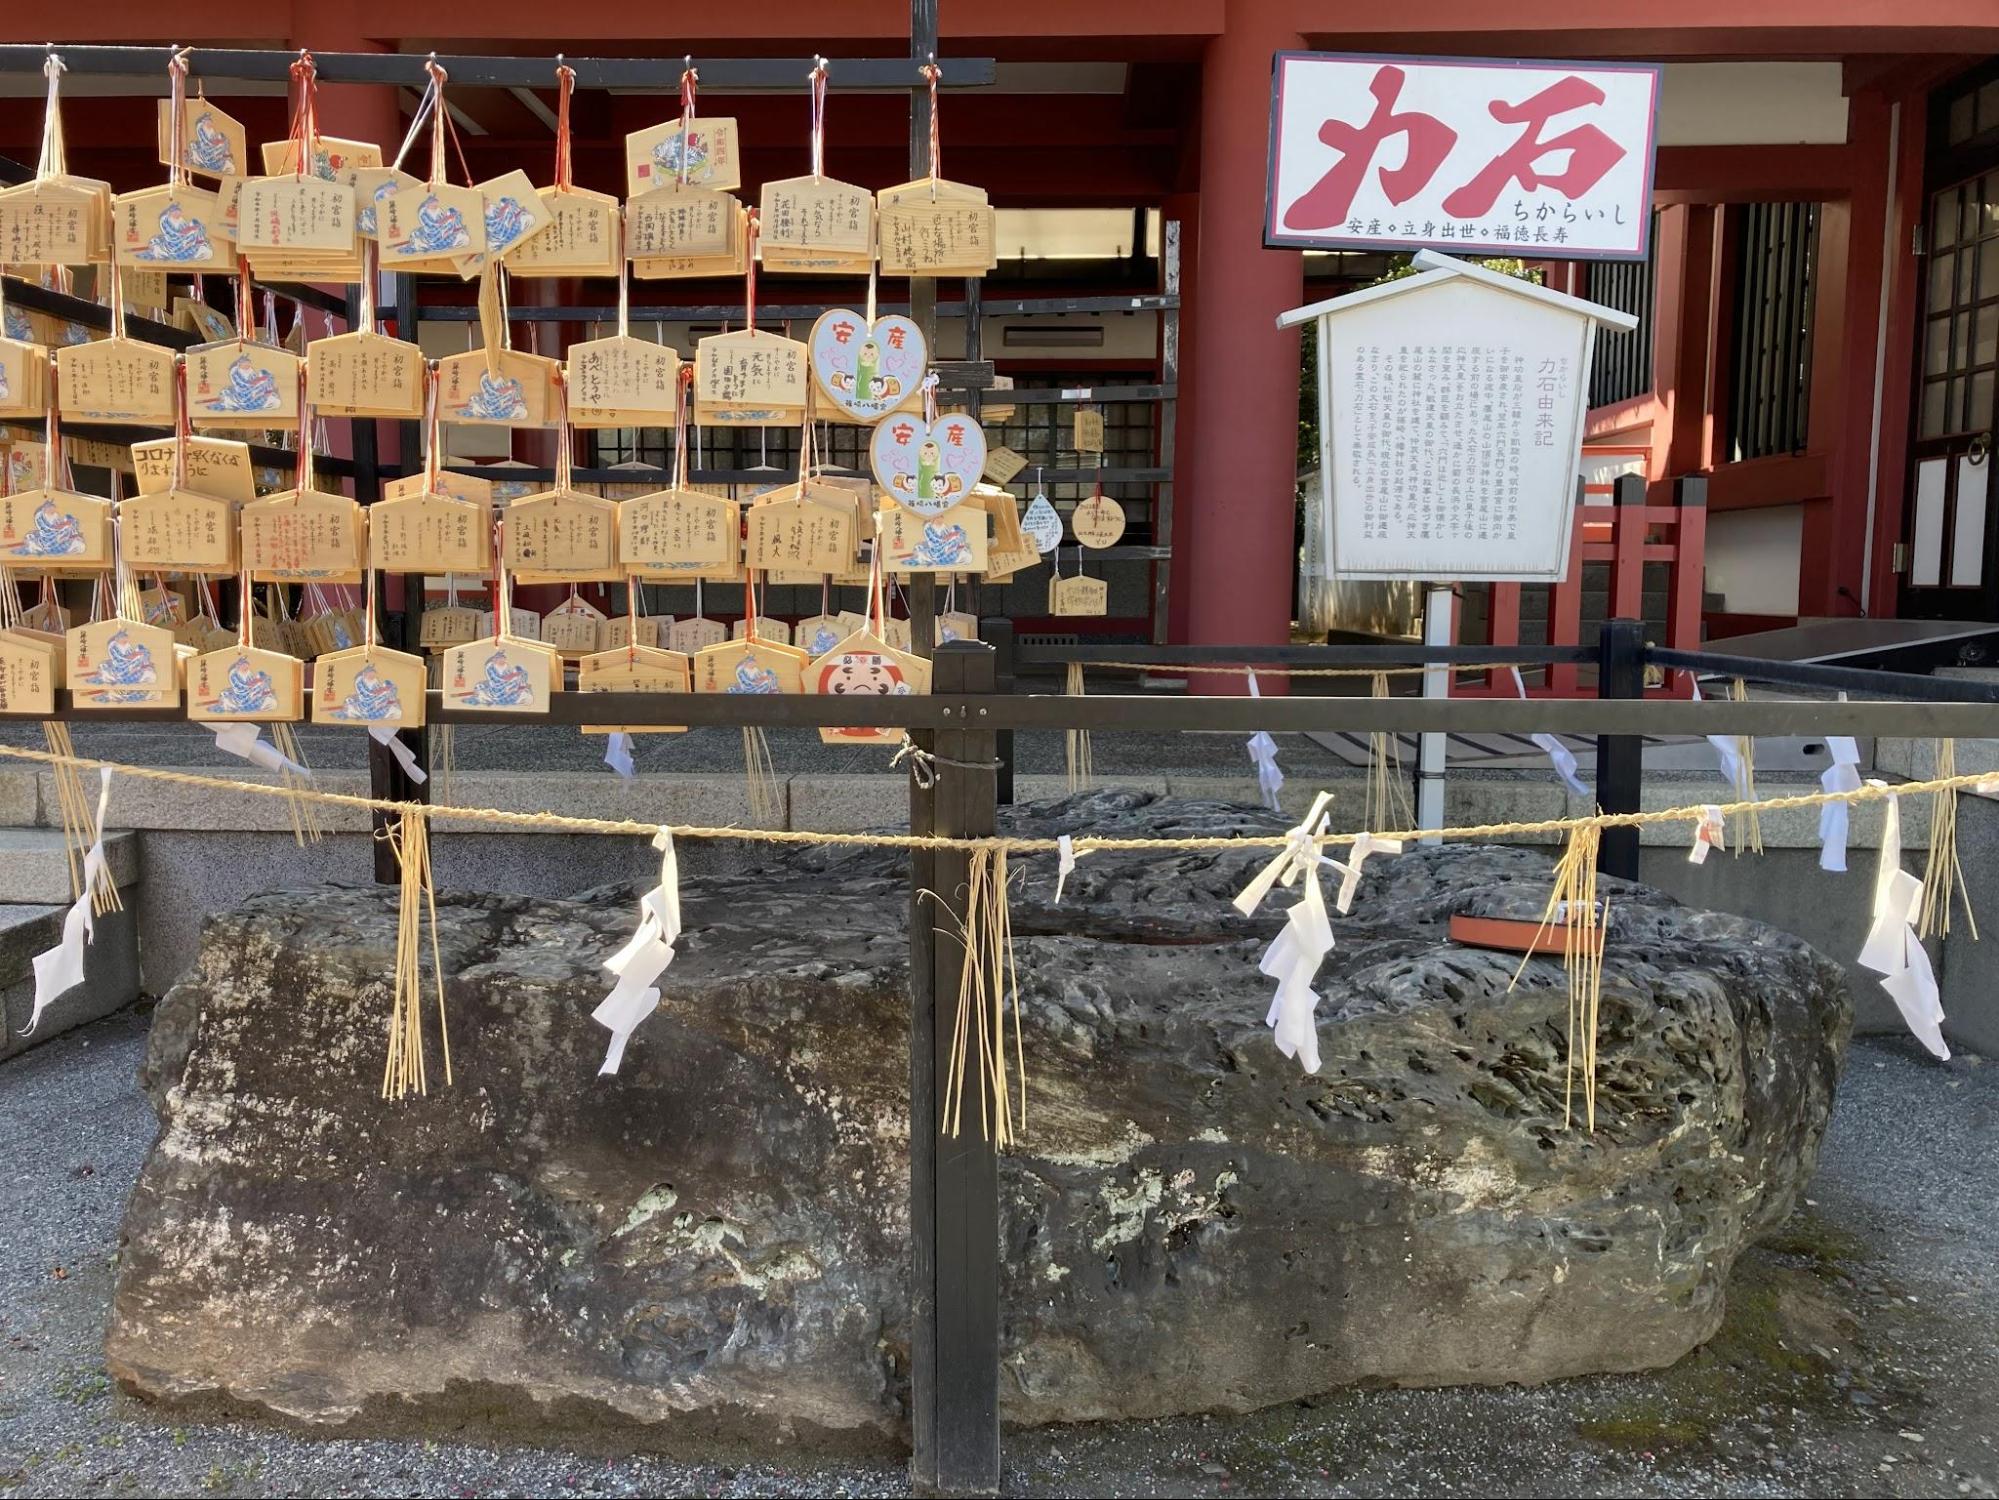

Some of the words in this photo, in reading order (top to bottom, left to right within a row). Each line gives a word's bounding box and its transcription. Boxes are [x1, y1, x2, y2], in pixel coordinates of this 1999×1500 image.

[1283, 65, 1628, 231] 力石
[331, 193, 343, 228] 初宮詣
[588, 208, 599, 243] 初宮詣
[707, 200, 718, 234] 初宮詣
[848, 195, 861, 231] 初宮詣
[968, 210, 979, 246] 初宮詣
[1514, 199, 1628, 226] ちからいし
[1347, 217, 1382, 236] 安産
[1401, 220, 1478, 239] 立身出世
[1494, 223, 1569, 244] 福徳長寿
[832, 321, 855, 345] 安
[887, 326, 907, 350] 産
[149, 359, 159, 394] 初宮詣
[393, 353, 404, 389] 初宮詣
[655, 354, 666, 391] 初宮詣
[786, 348, 797, 384] 初宮詣
[1534, 357, 1557, 446] 力石由来記
[891, 422, 915, 446] 安
[946, 423, 965, 447] 産
[135, 448, 241, 466] コロナ早くなくな
[141, 462, 208, 476] りますうに
[330, 513, 341, 548] 初宮詣
[456, 513, 467, 548] 初宮詣
[588, 514, 599, 549] 初宮詣
[706, 507, 717, 542] 初宮詣
[828, 518, 840, 553] 初宮詣
[30, 660, 40, 693] 初宮詣
[843, 656, 853, 665] 必
